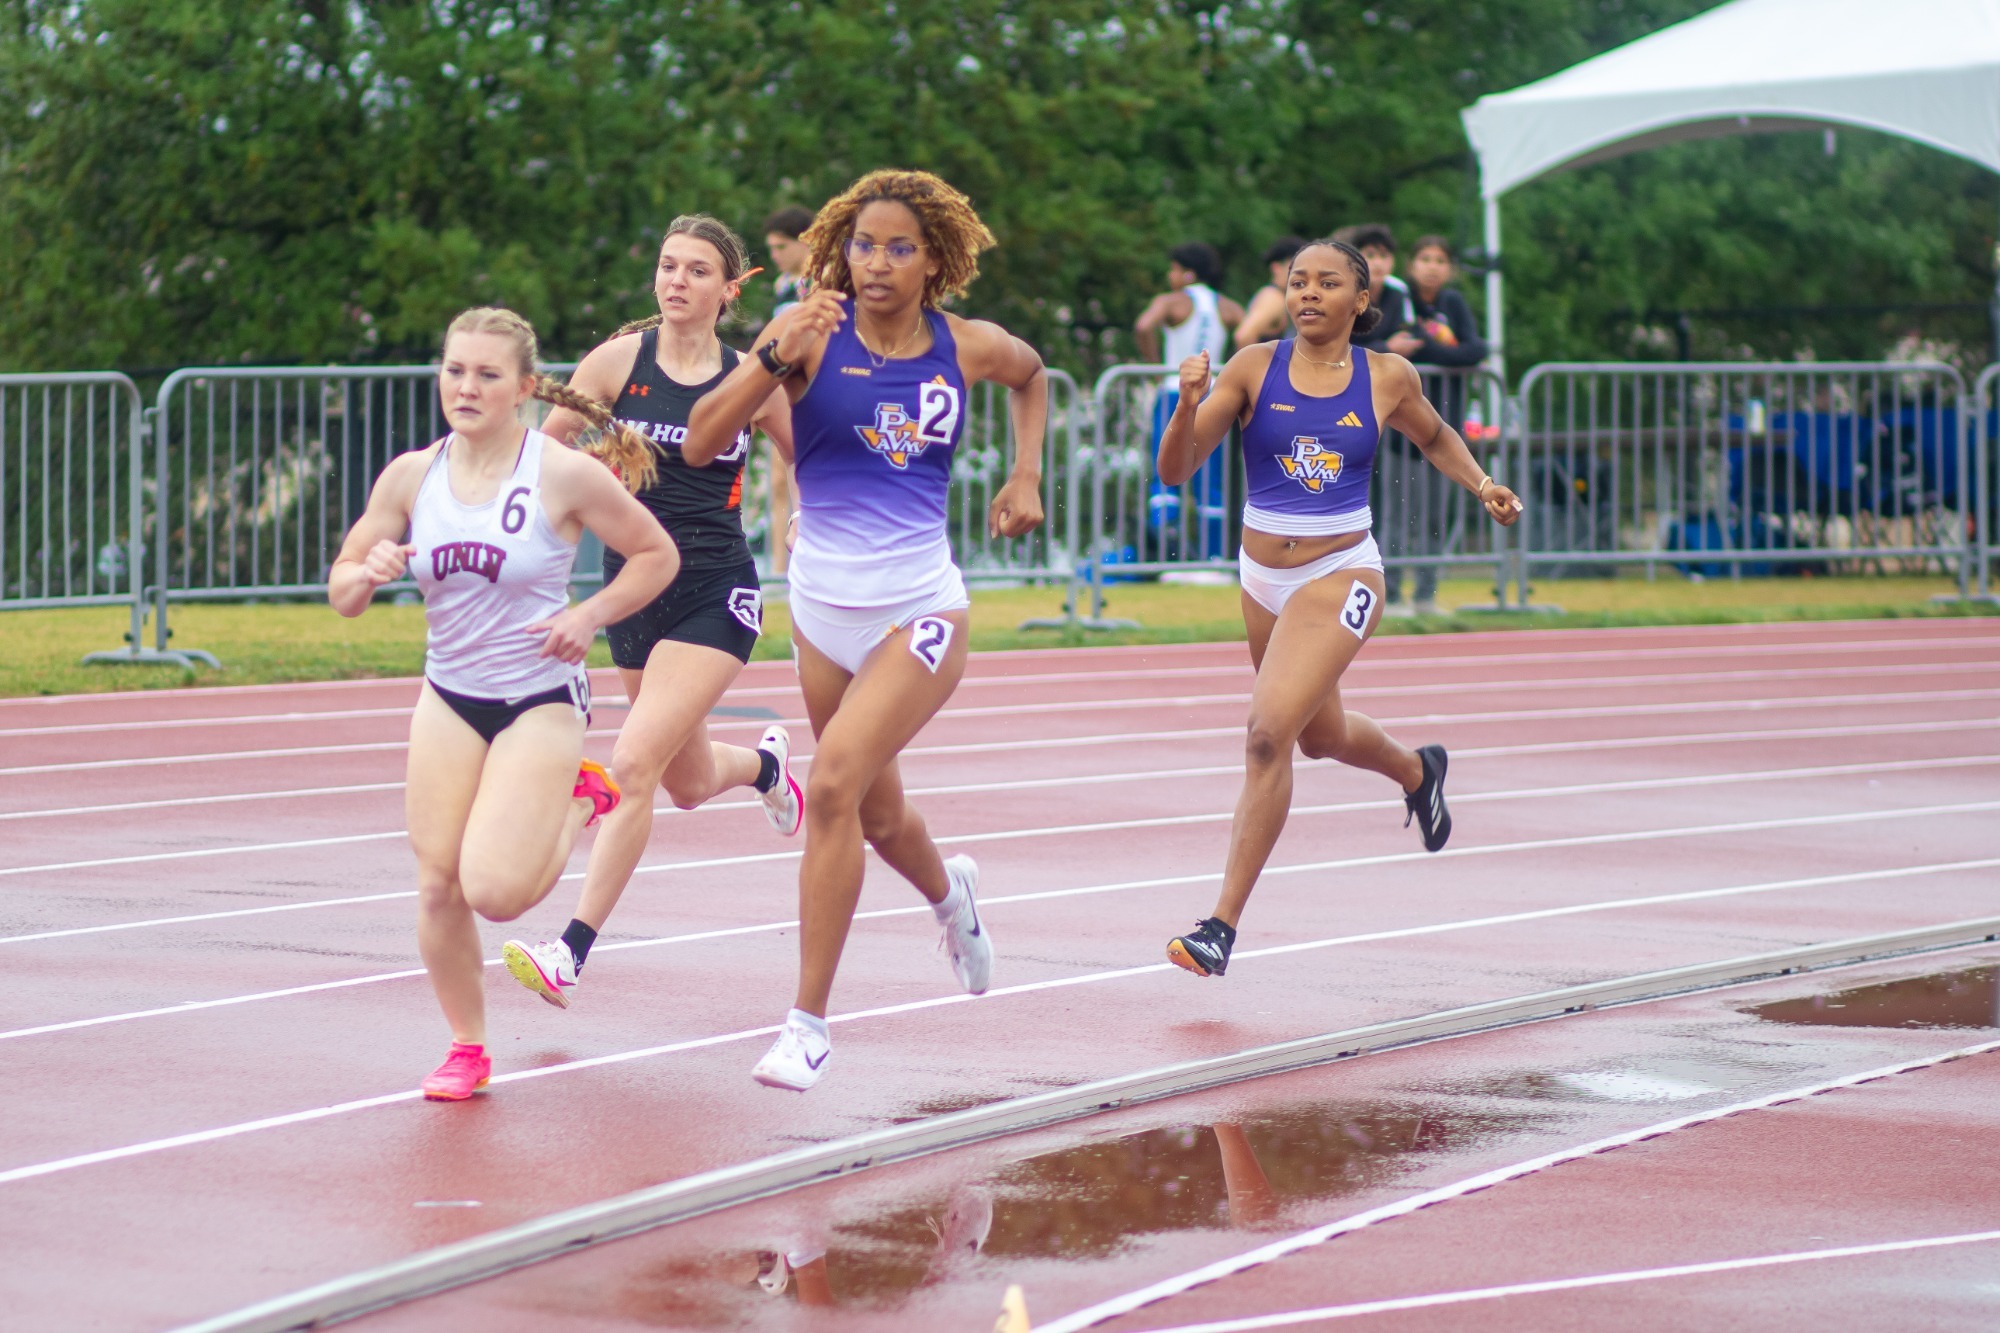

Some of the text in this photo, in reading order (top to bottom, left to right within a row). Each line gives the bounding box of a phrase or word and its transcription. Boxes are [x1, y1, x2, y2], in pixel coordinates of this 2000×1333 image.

[926, 388, 953, 439] 2
[1275, 403, 1296, 413] SWAC
[501, 486, 531, 534] 6
[430, 540, 507, 584] UNLV
[733, 591, 757, 627] 5
[1345, 587, 1371, 630] 3
[915, 619, 946, 666] 2
